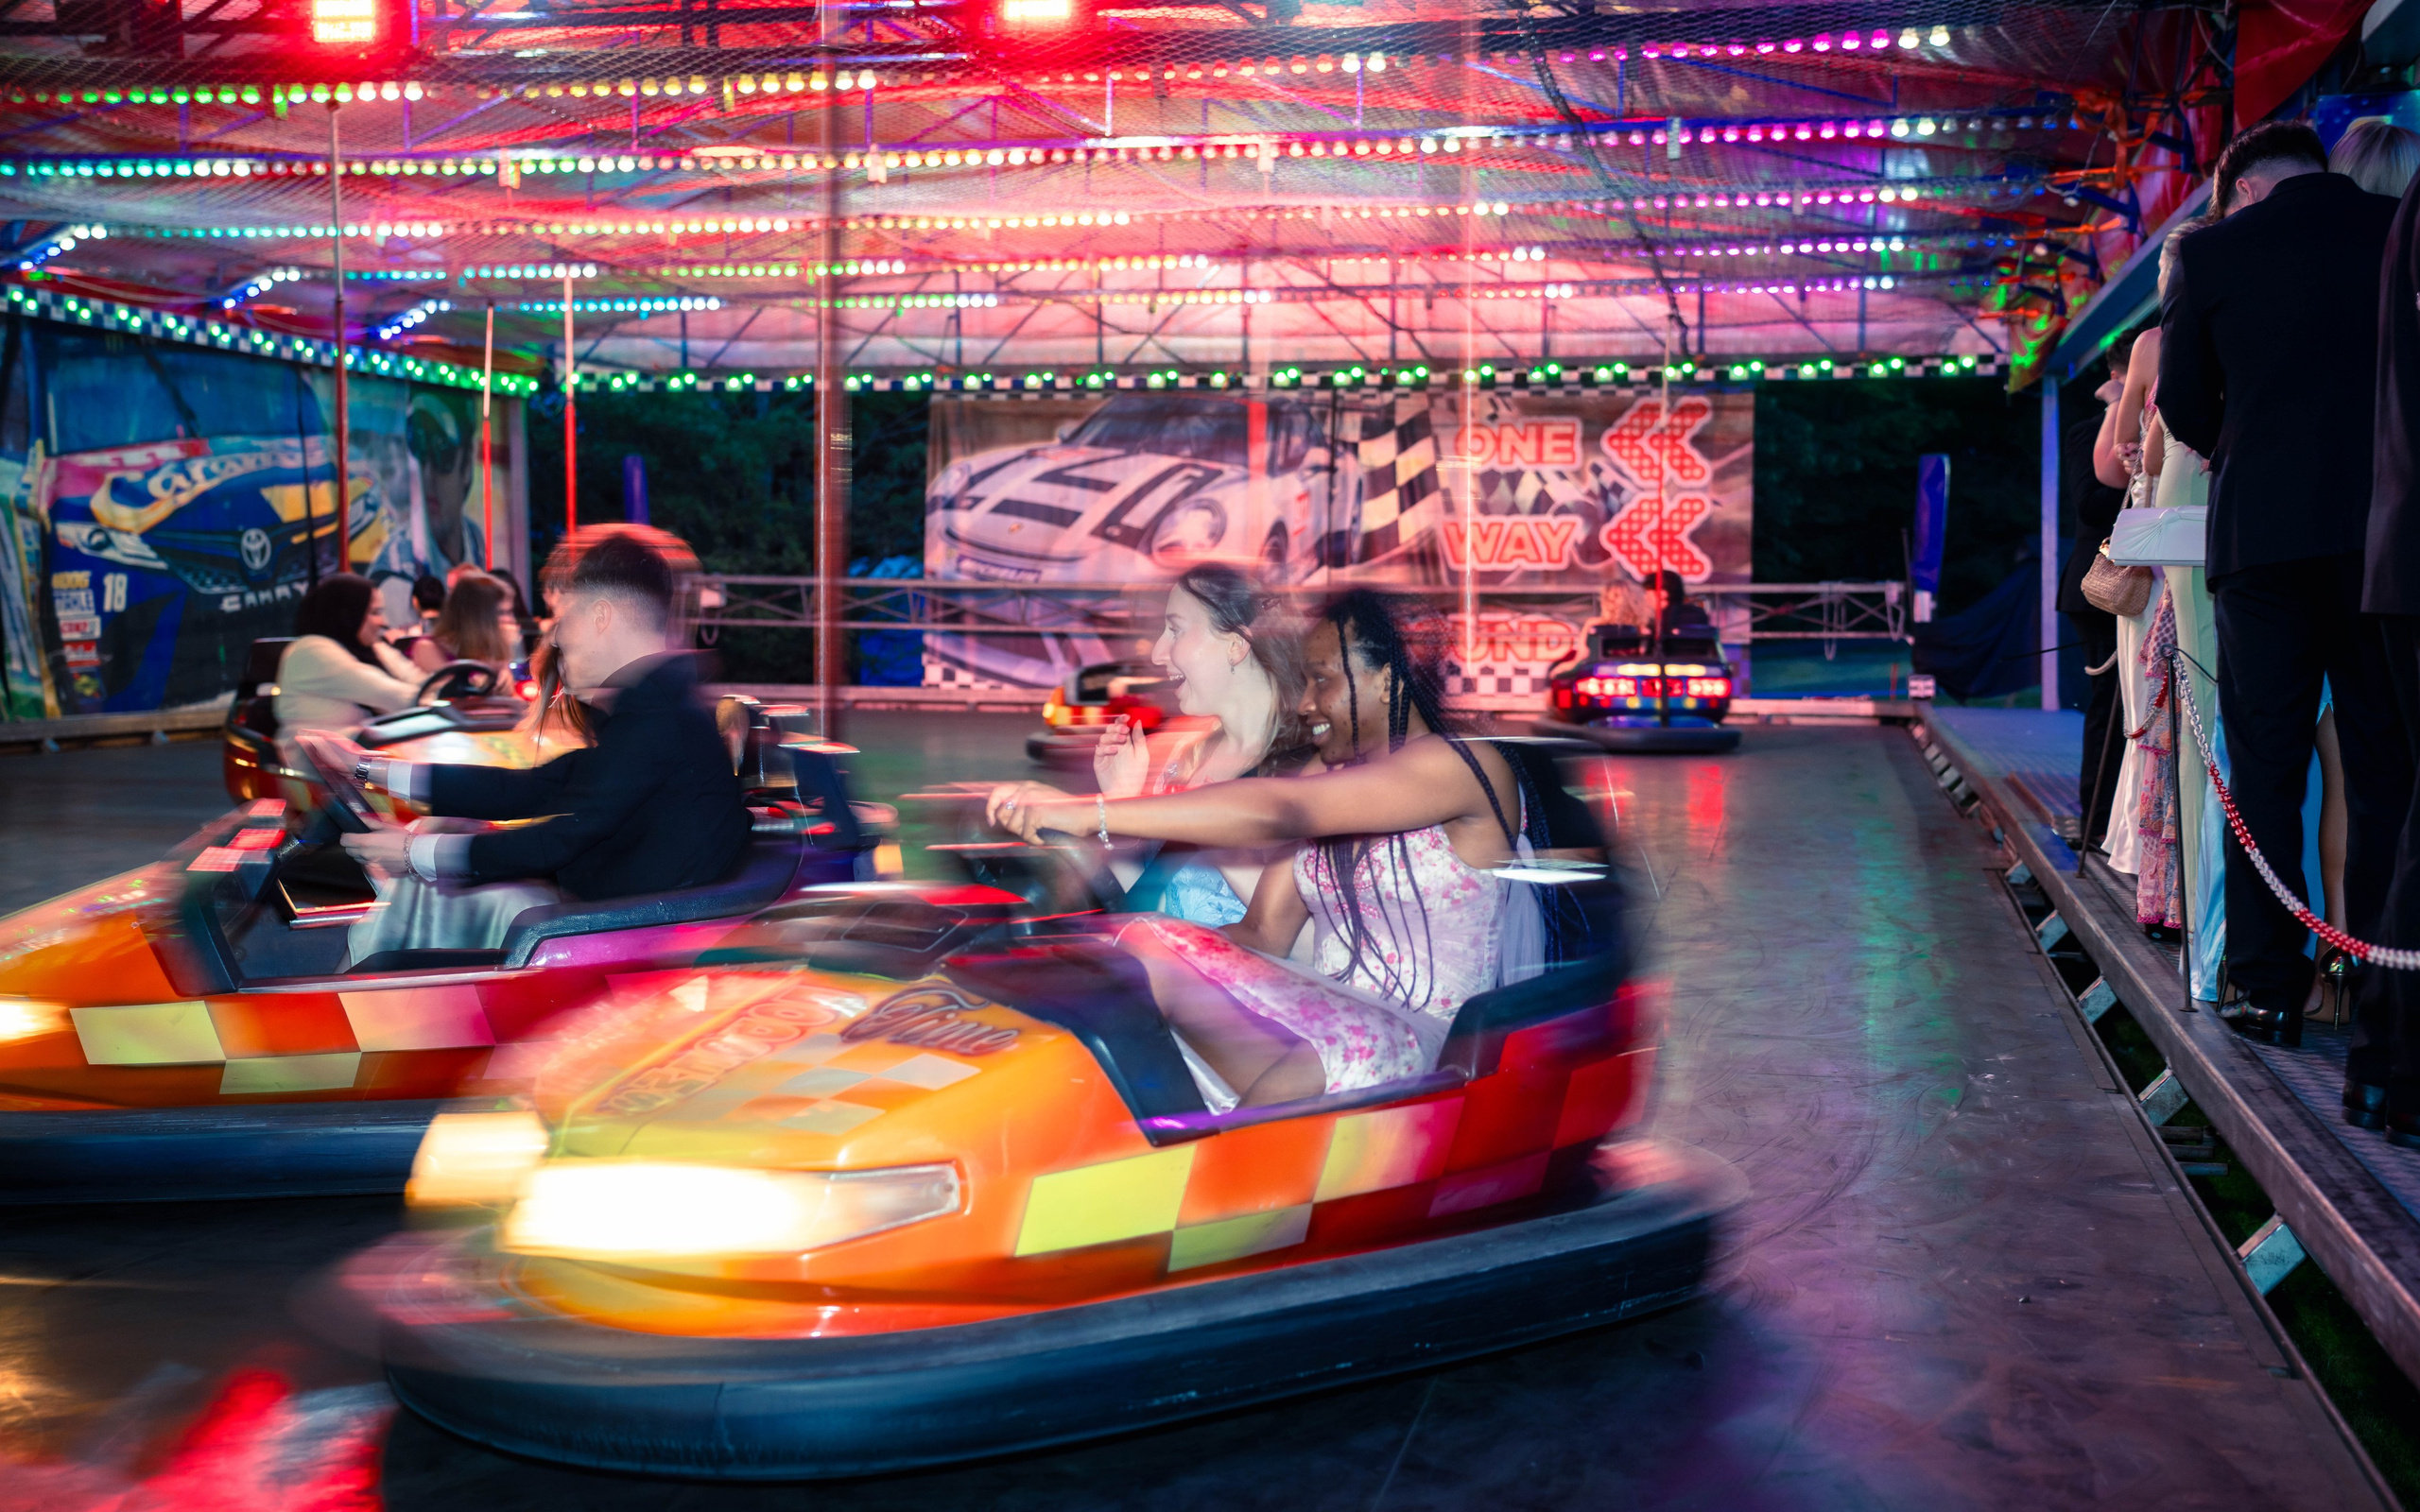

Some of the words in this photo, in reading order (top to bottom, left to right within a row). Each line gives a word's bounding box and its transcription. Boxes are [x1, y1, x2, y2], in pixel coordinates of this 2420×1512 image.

[1456, 421, 1577, 466] ONE
[1443, 520, 1577, 564] WAY
[102, 572, 129, 613] 18
[218, 579, 310, 613] CAMRY
